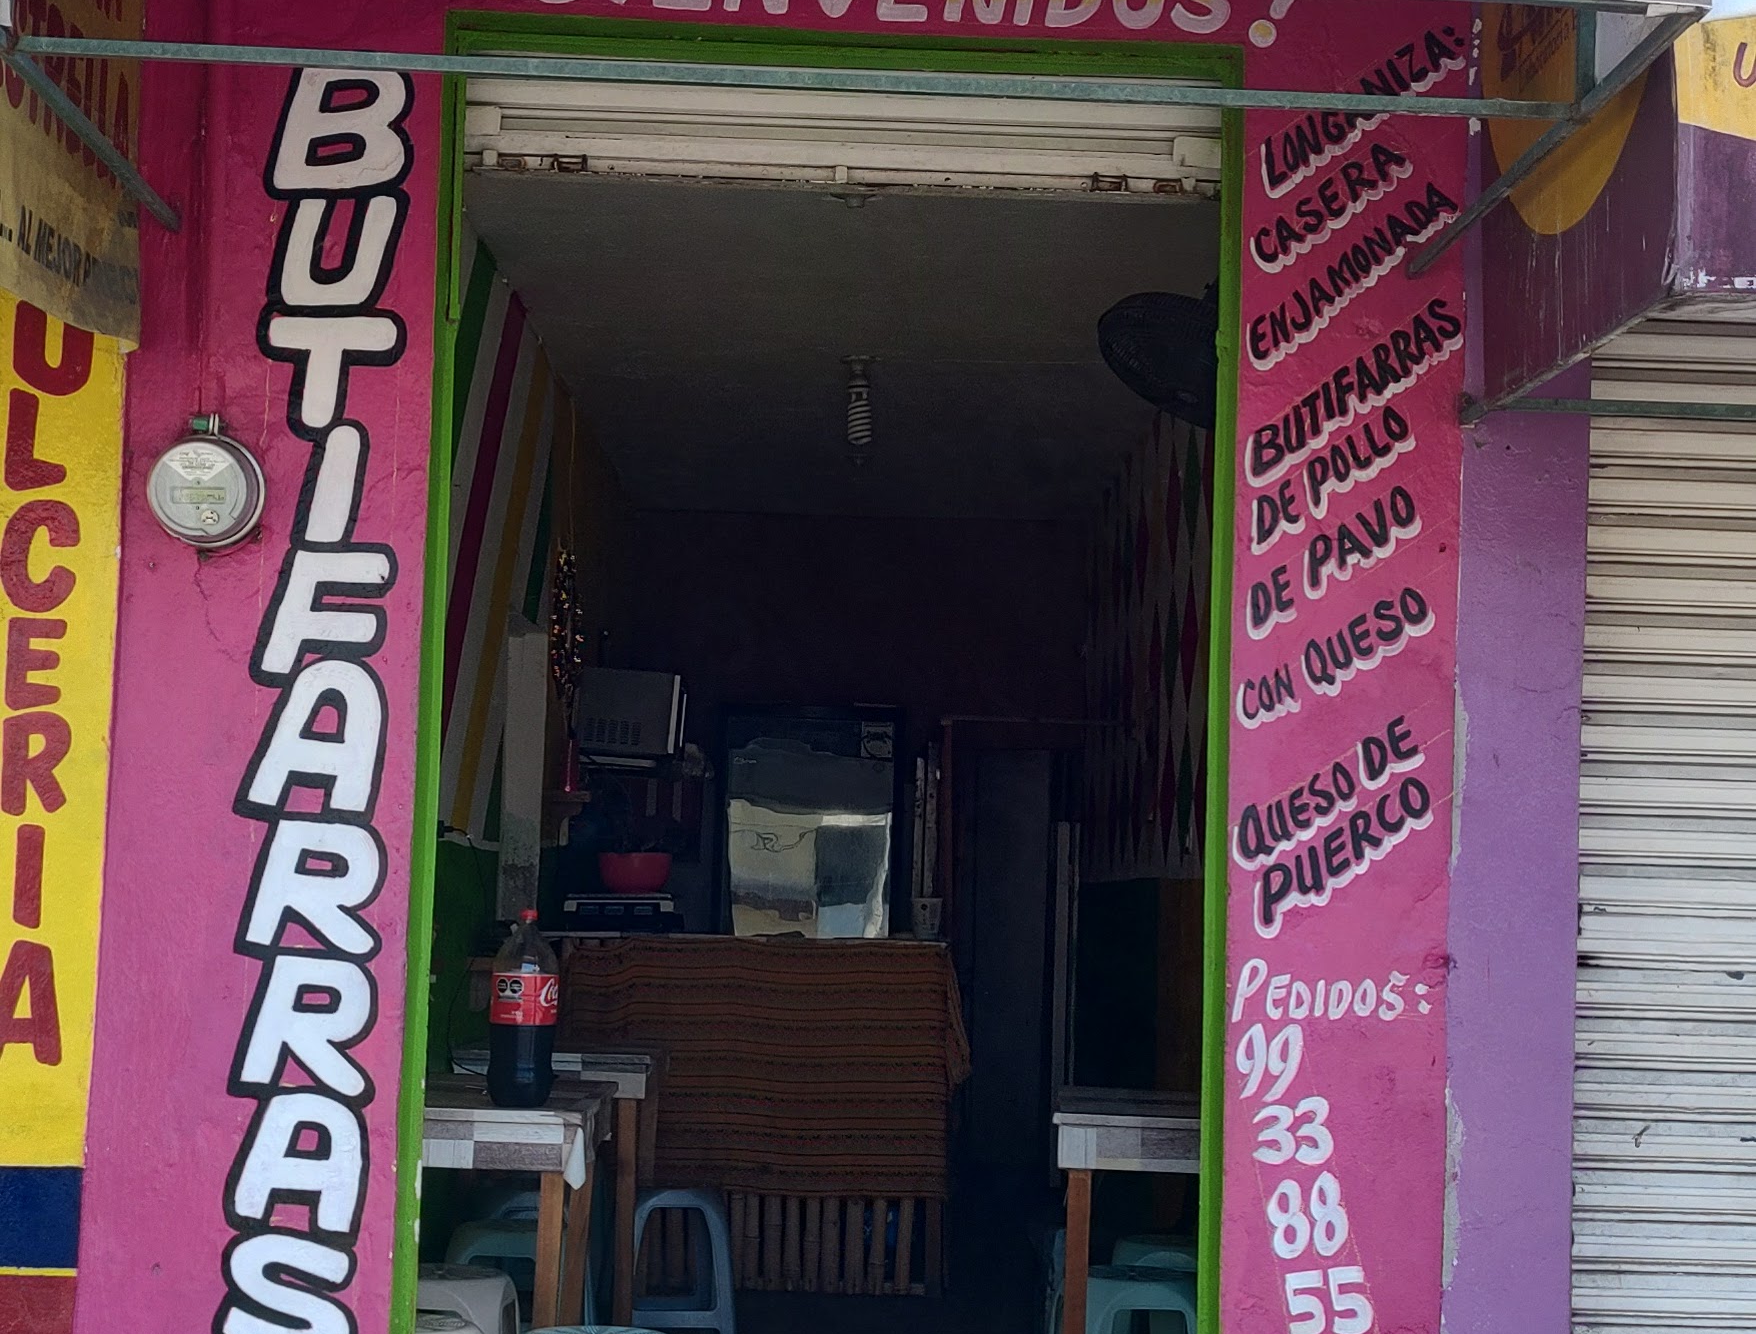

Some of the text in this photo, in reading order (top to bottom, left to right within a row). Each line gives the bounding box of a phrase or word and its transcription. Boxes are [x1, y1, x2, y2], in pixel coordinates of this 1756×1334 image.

[1246, 181, 1462, 371] ENJAMONADA
[1251, 143, 1414, 272] CASERA
[1245, 298, 1464, 487] BUTIFARRAS
[1252, 405, 1416, 555] DE POLLO
[1246, 485, 1422, 640] DE PAVO
[1237, 587, 1436, 728] CON QUESO
[1232, 715, 1426, 870] QUESO DE
[1254, 776, 1435, 939] PUERCO
[1234, 1022, 1304, 1103] 99
[1251, 1095, 1334, 1166] 33
[1266, 1170, 1349, 1260] 88
